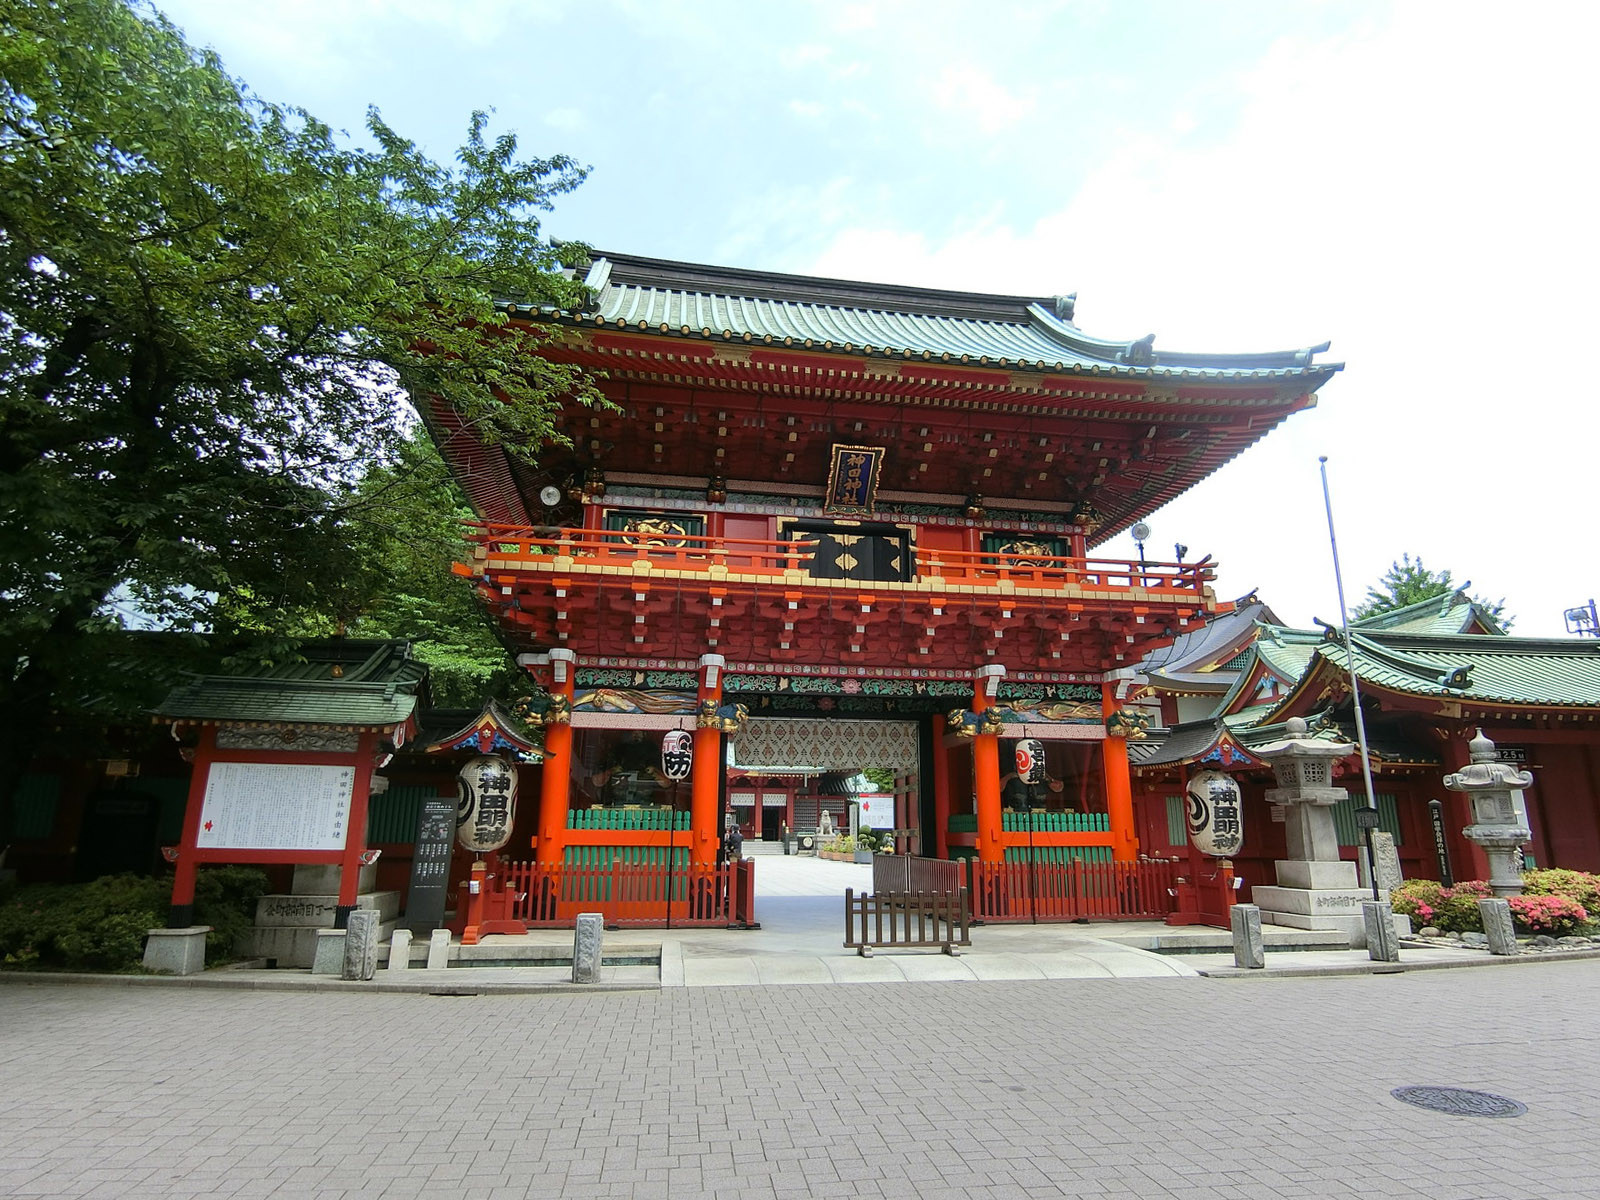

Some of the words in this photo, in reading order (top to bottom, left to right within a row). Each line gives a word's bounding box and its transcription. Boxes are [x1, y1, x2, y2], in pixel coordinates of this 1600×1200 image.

[475, 773, 510, 844] 神田明神
[1209, 786, 1240, 849] 神田明神
